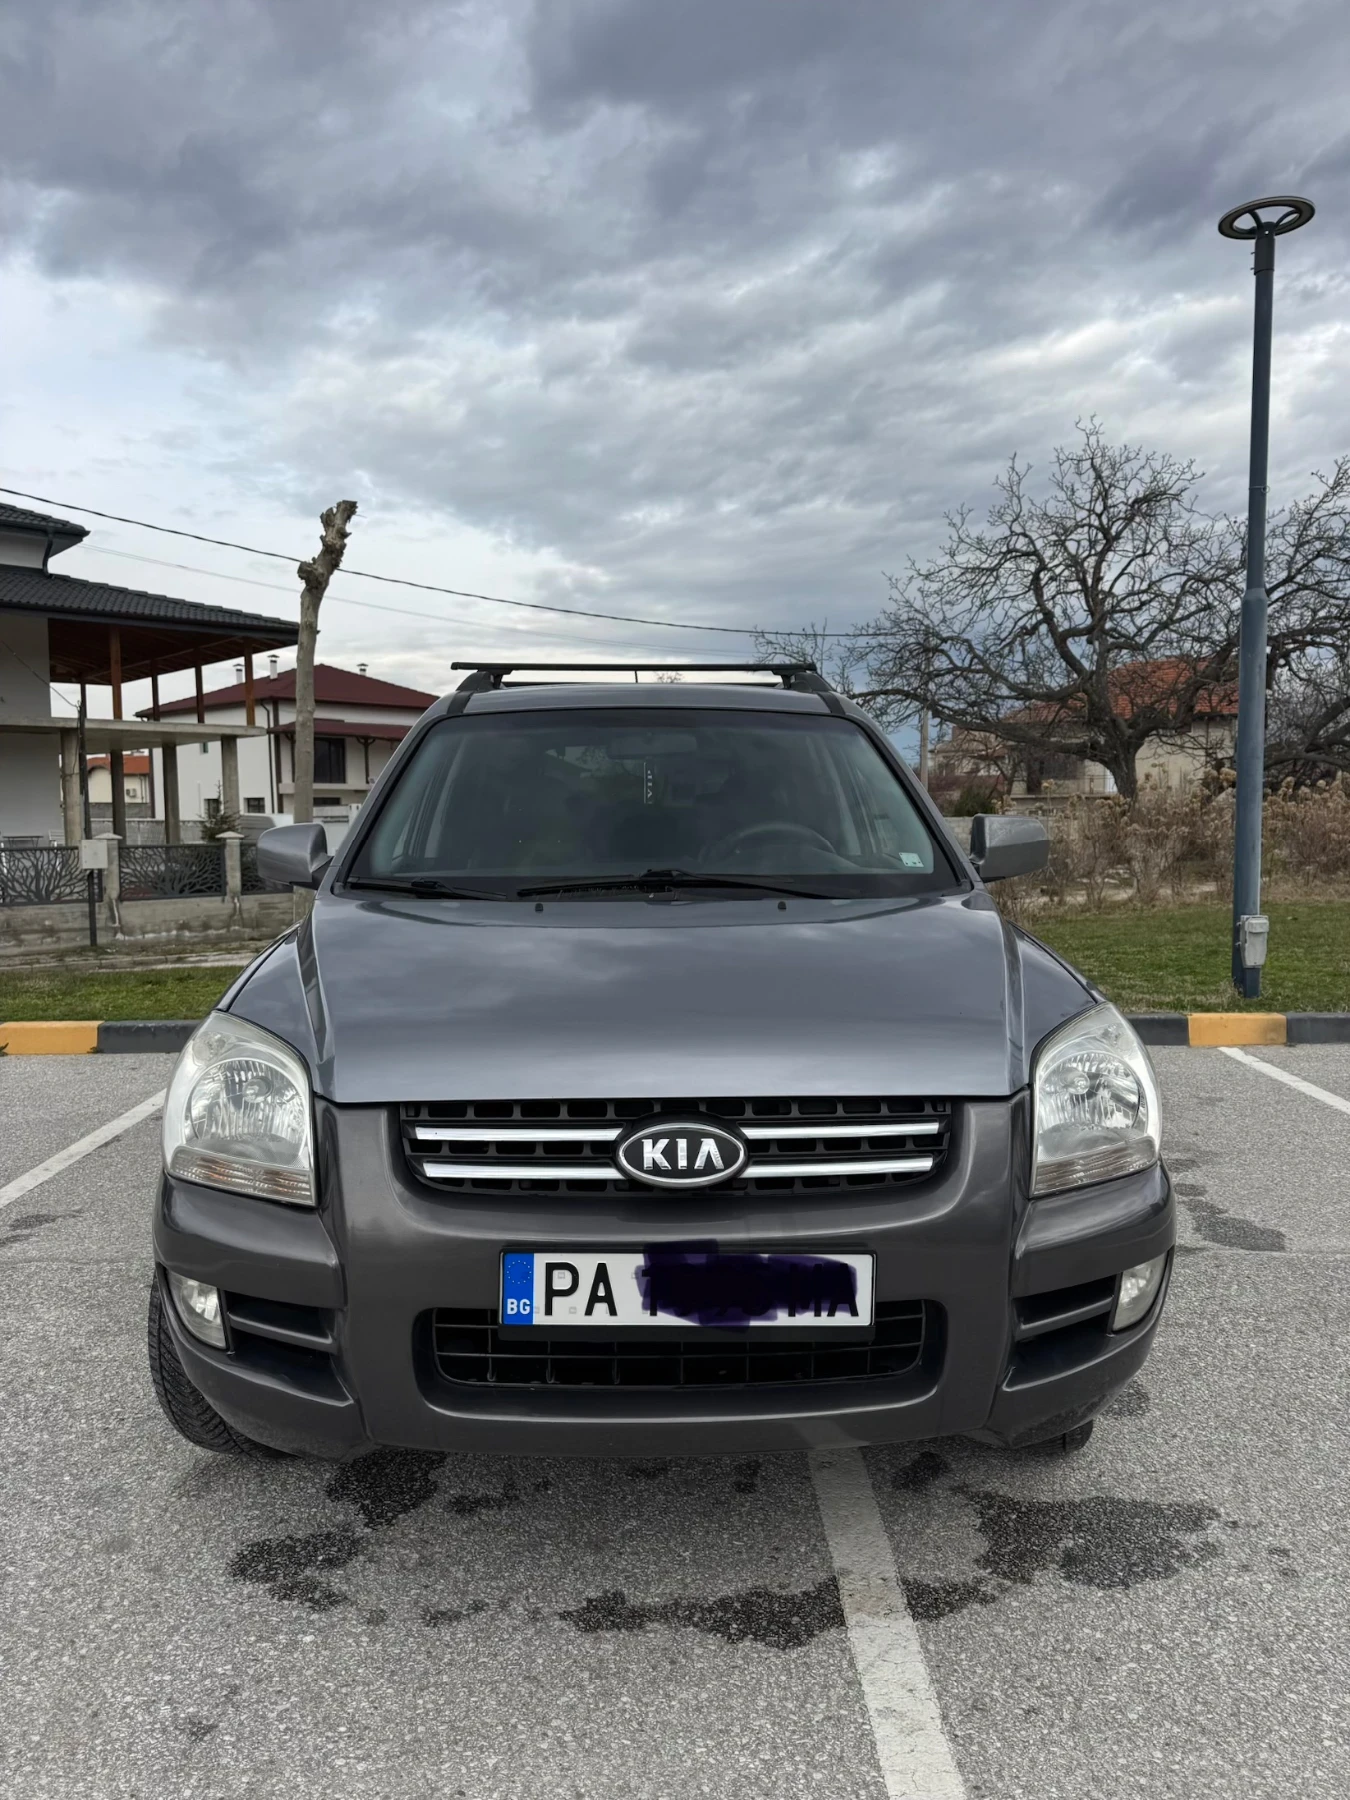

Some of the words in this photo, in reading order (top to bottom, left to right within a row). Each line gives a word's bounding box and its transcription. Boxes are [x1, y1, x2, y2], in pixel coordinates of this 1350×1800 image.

[641, 1138, 725, 1170] KIA
[544, 1261, 618, 1317] PA
[506, 1298, 532, 1315] BG
